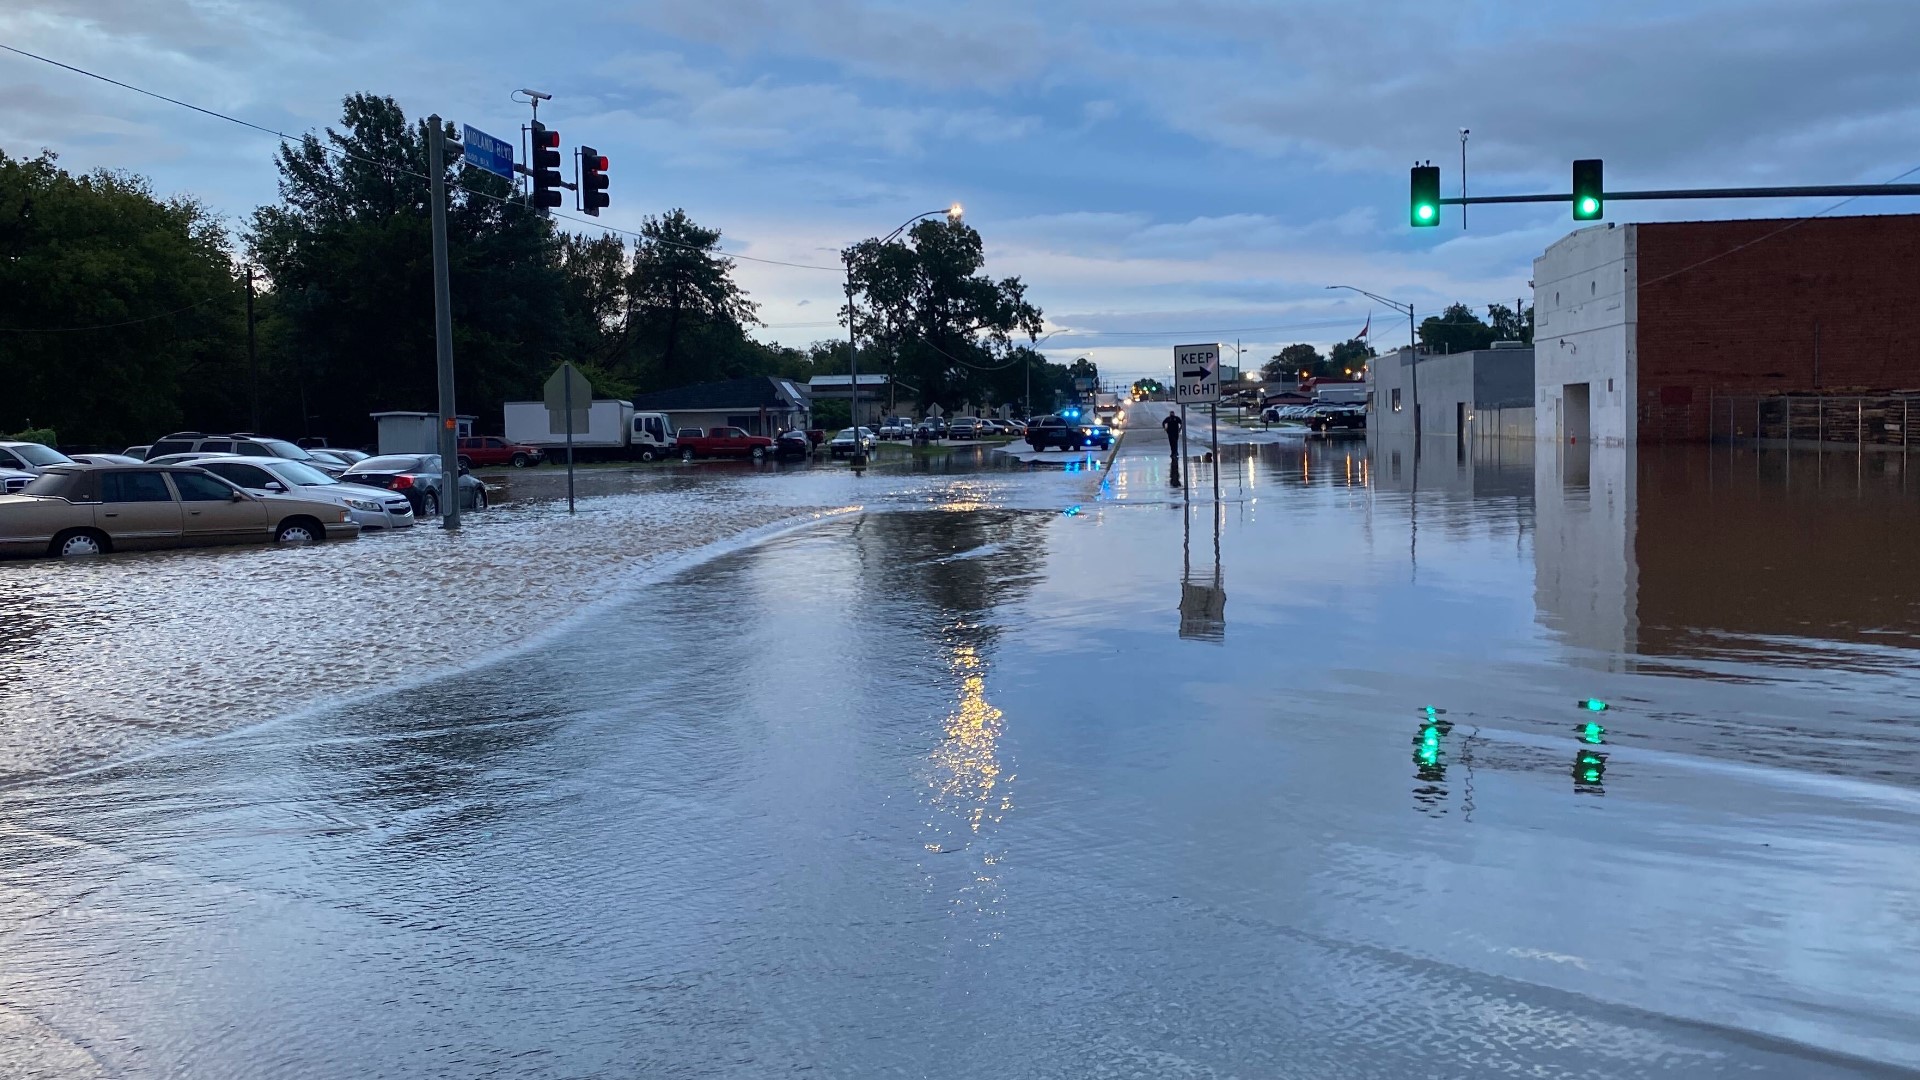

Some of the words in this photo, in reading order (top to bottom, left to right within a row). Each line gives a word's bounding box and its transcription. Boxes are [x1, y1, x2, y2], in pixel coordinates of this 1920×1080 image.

[465, 129, 494, 153] MIDLAND
[496, 142, 513, 161] BLVD
[1181, 352, 1214, 365] KEEP
[1179, 383, 1217, 396] RIGHT
